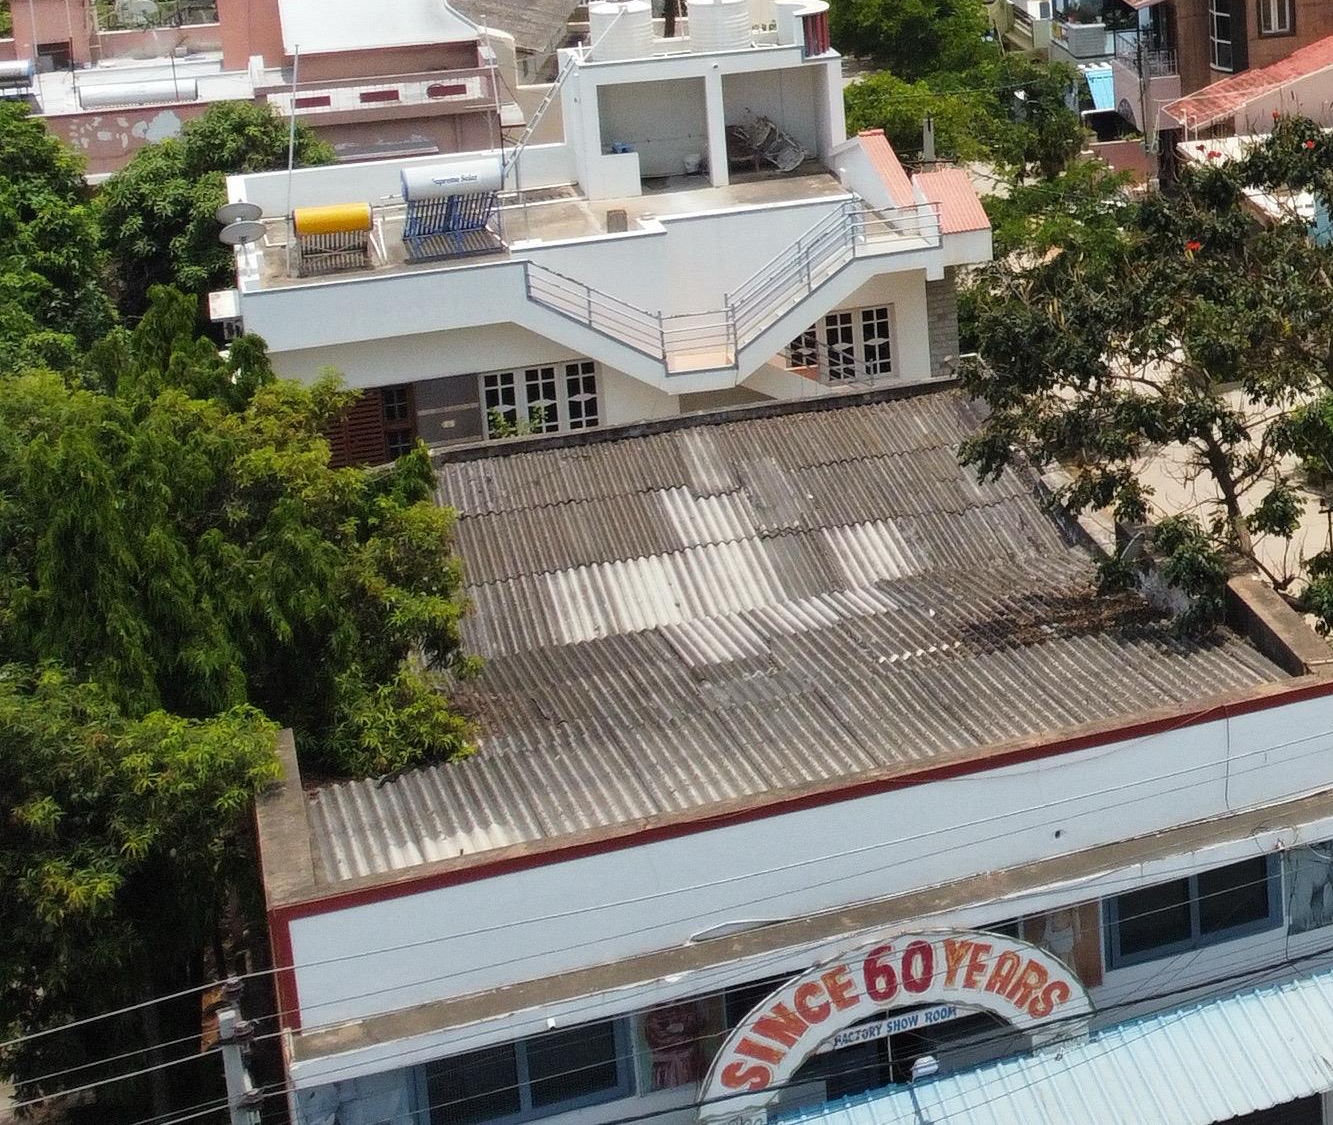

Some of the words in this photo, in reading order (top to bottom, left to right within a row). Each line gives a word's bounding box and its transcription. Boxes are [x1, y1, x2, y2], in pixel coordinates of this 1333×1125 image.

[720, 964, 862, 1092] SINCE
[862, 939, 935, 1002] 60
[942, 938, 1071, 1019] YEARS
[834, 1023, 882, 1047] FACTORY
[886, 1014, 919, 1034] SHOW
[924, 1006, 957, 1023] ROOM
